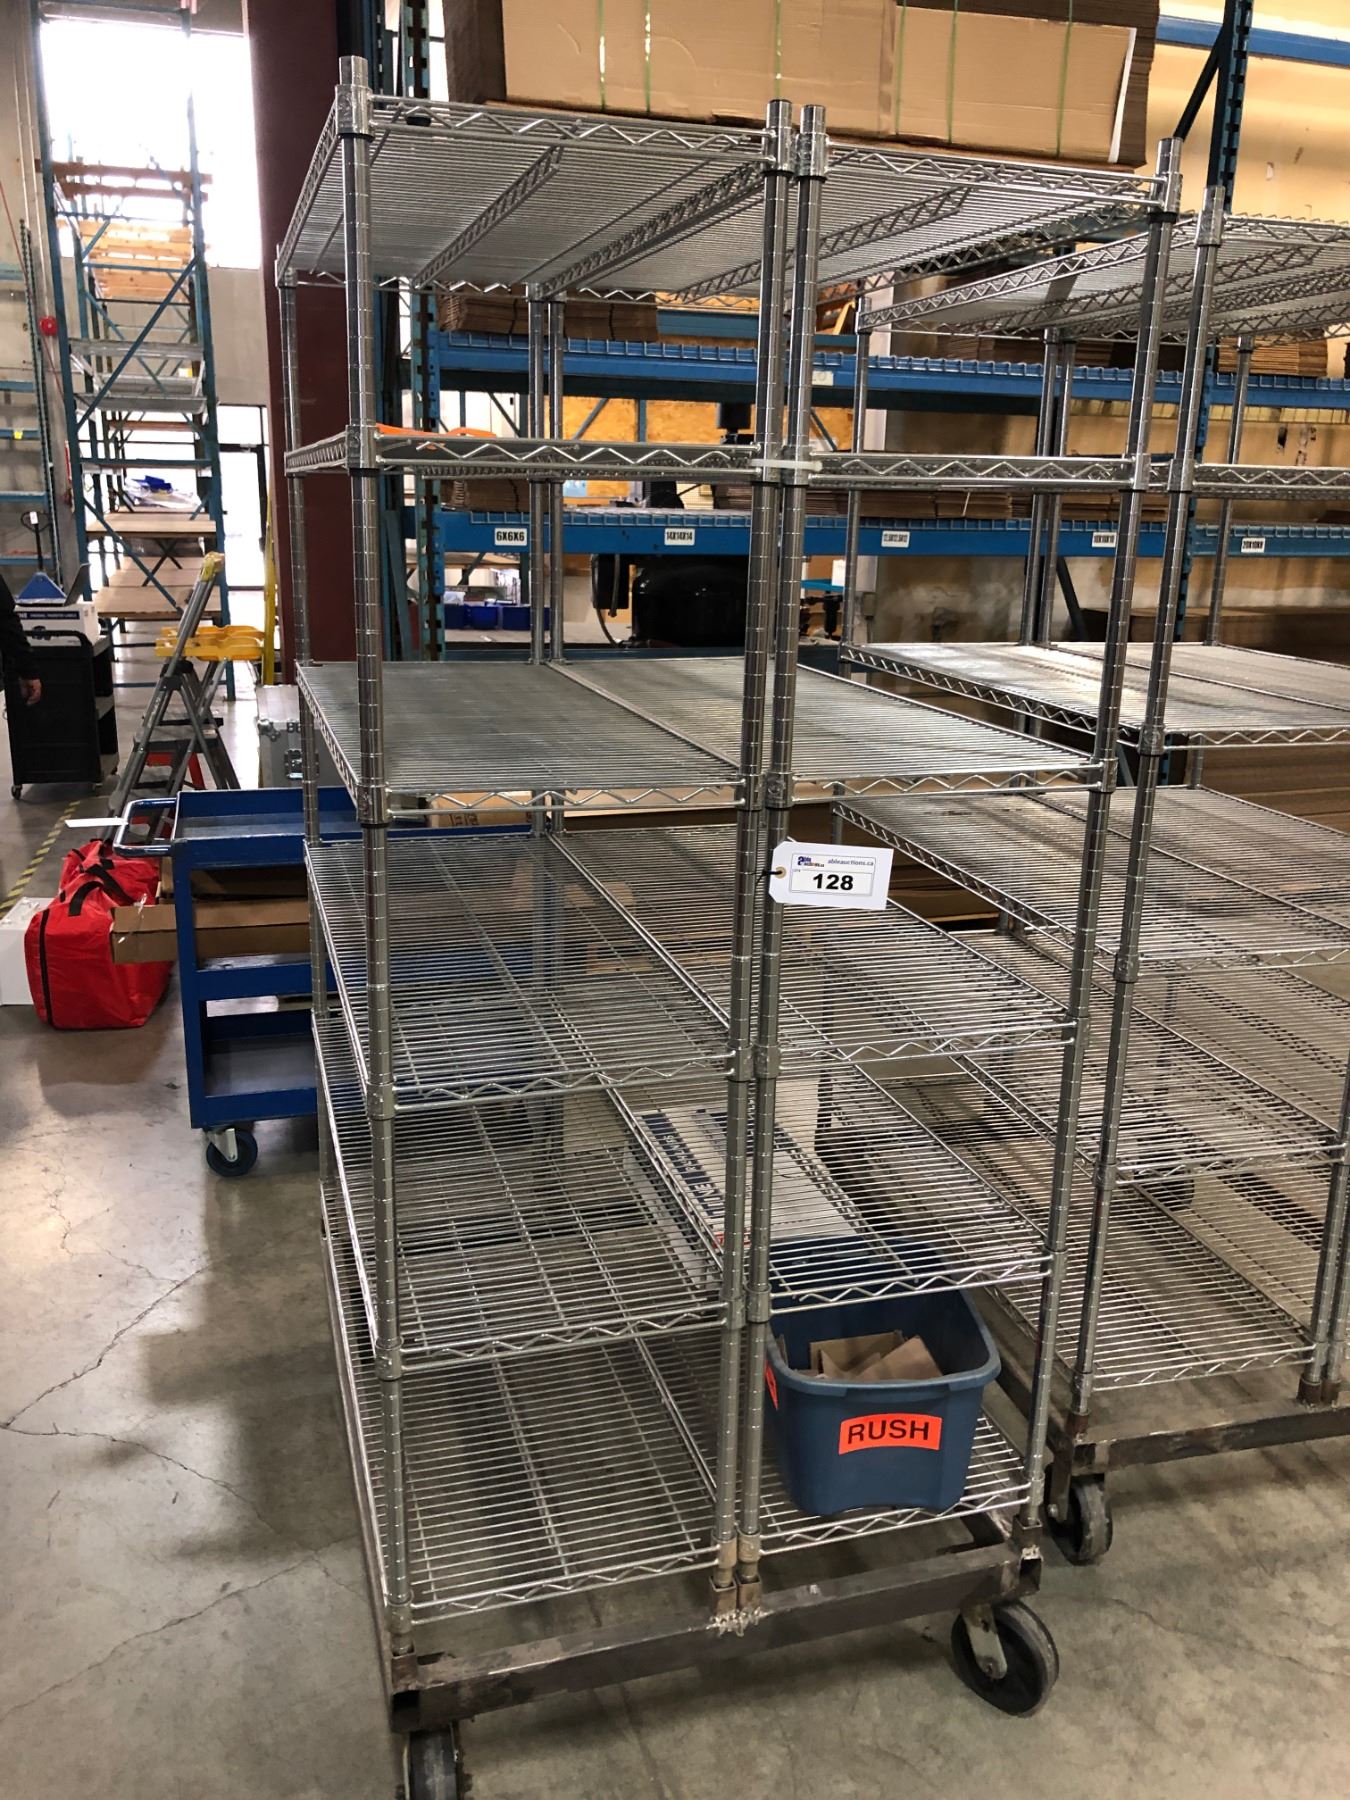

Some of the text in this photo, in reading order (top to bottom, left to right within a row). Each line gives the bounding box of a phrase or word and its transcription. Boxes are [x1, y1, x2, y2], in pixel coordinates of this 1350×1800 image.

[496, 531, 525, 541] 6X6X6
[813, 873, 854, 891] 128
[847, 1419, 930, 1444] RUSH
